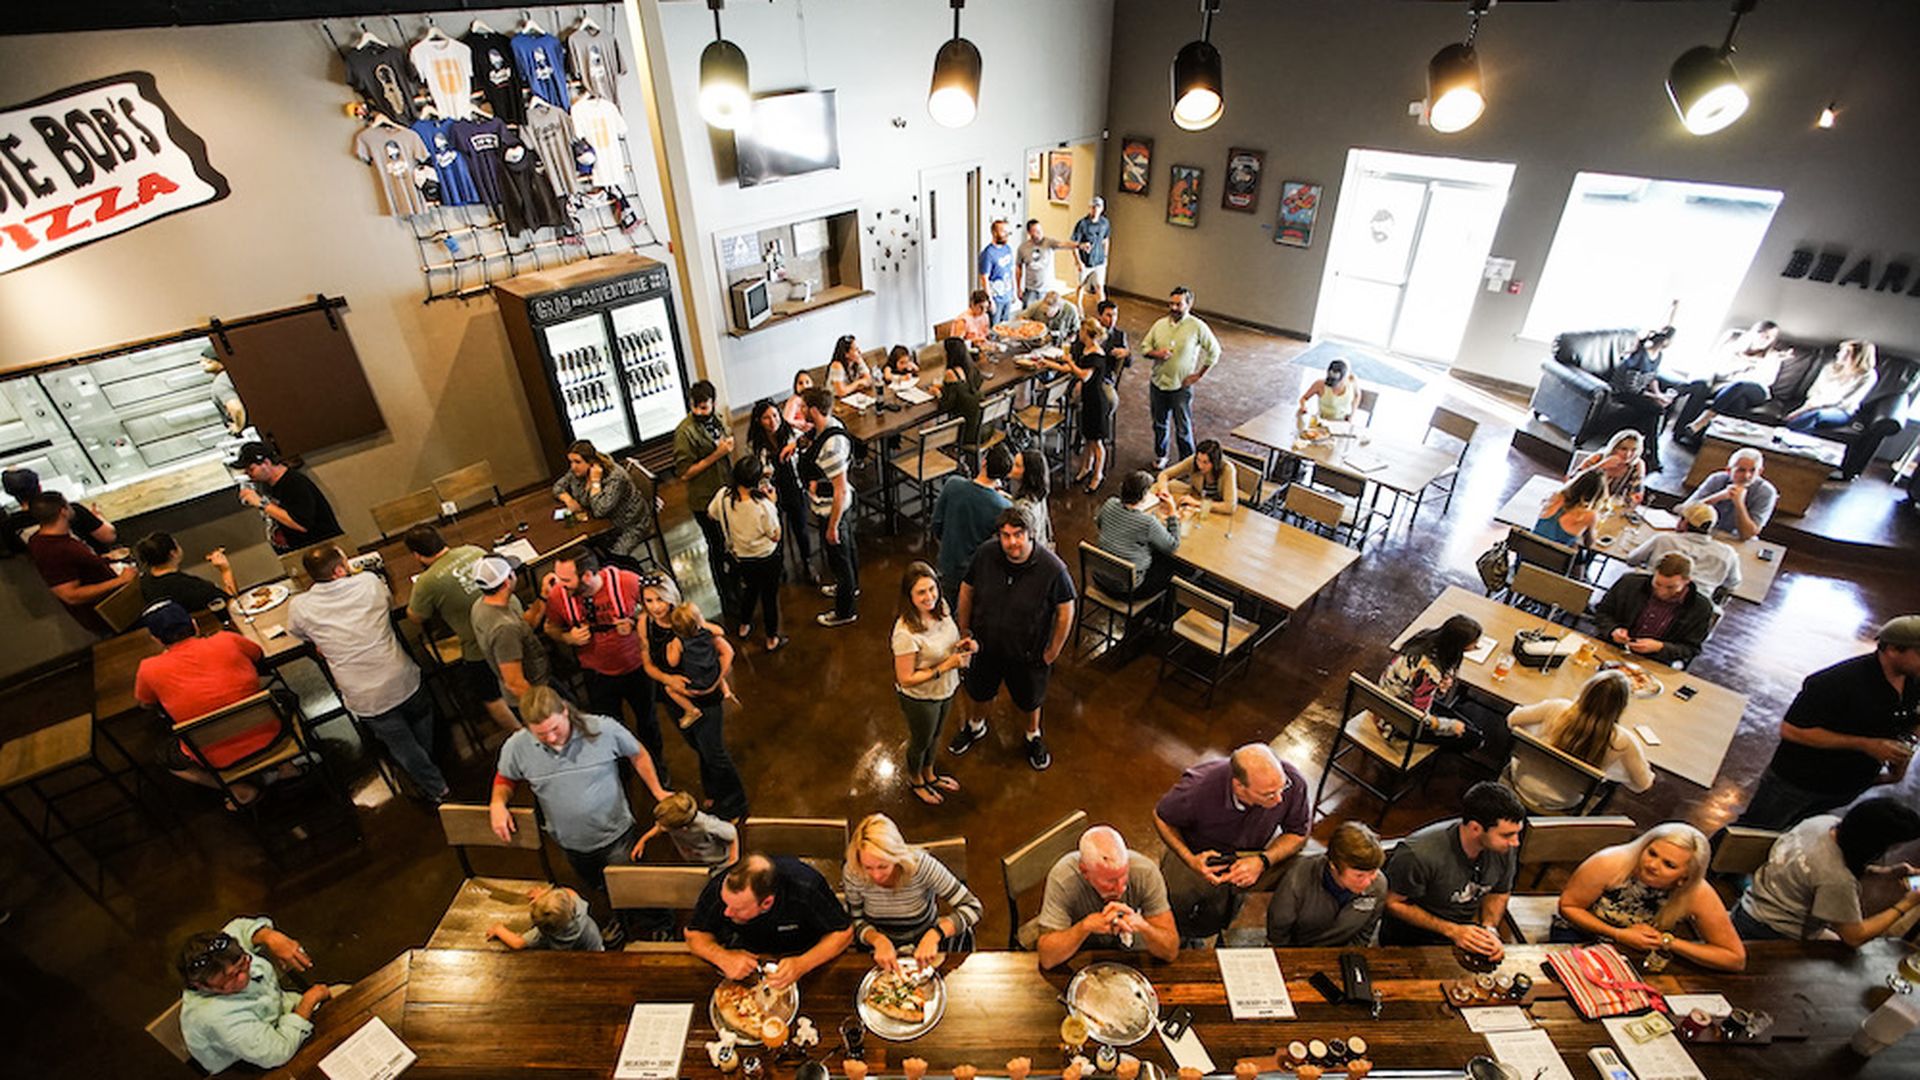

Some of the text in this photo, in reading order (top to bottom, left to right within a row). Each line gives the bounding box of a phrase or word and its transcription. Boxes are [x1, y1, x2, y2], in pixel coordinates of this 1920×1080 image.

[0, 97, 162, 214] IE BOB'S
[0, 171, 181, 252] IZZA
[534, 294, 572, 320] GRAB
[582, 277, 650, 305] ADVENTURE
